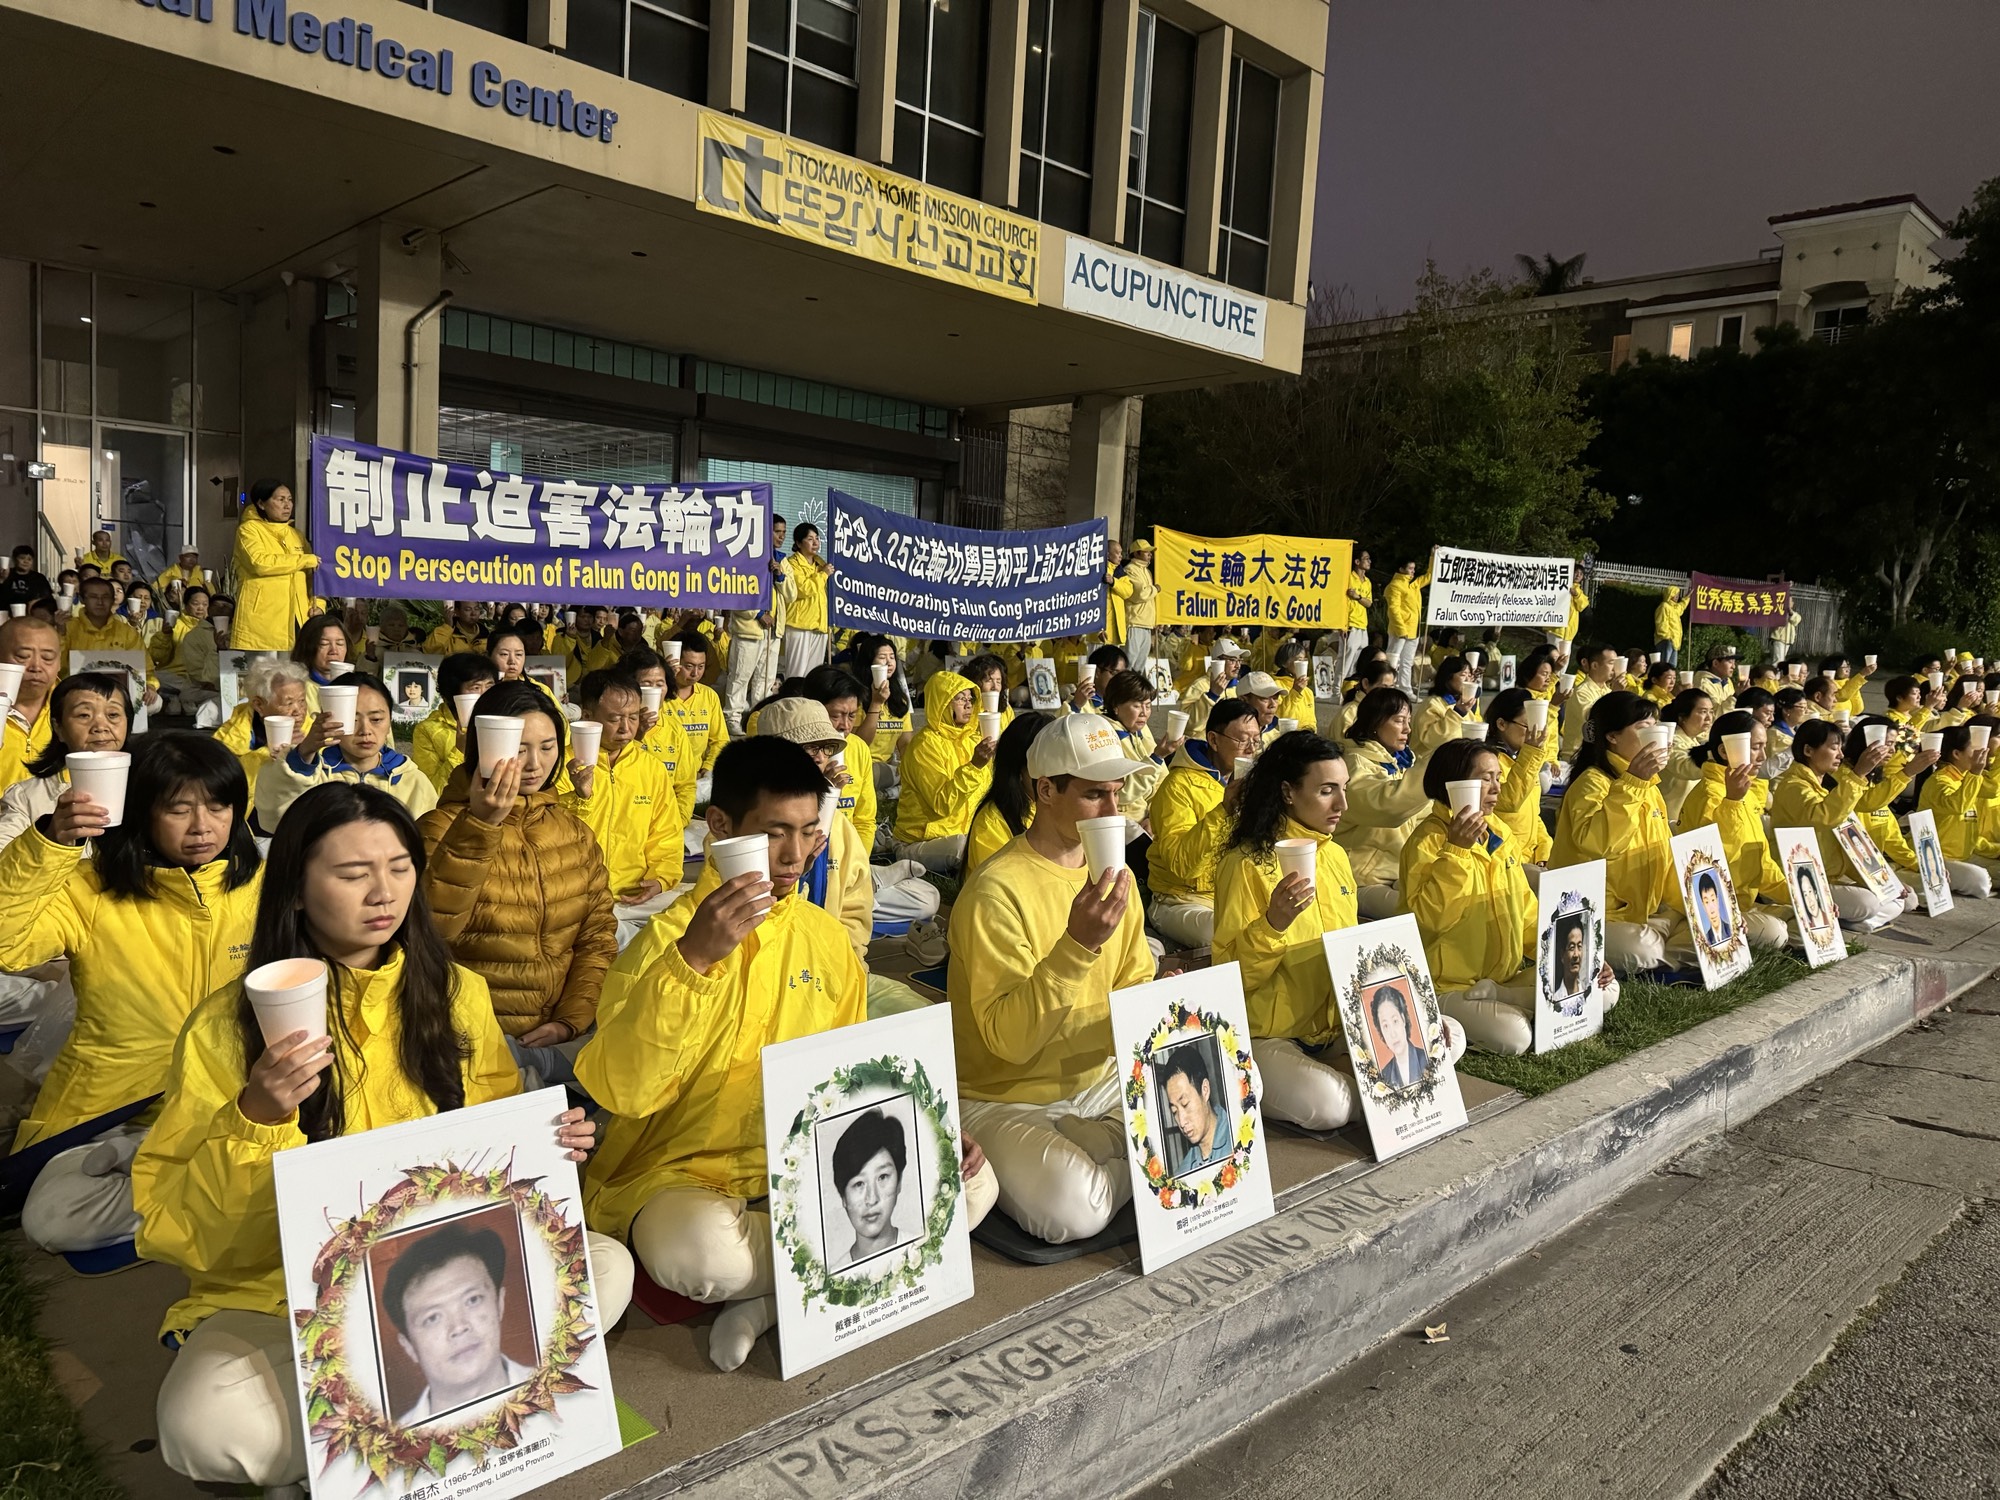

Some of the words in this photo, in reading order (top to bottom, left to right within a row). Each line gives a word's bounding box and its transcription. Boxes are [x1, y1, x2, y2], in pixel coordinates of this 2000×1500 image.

[236, 0, 453, 95] Medical
[472, 61, 618, 143] Center
[785, 149, 874, 195] TTOKAMSA
[877, 180, 921, 214] HOME
[924, 194, 981, 234] MISSION
[984, 216, 1037, 252] CHURCH
[783, 178, 1036, 298] 또감사선교교회
[1071, 253, 1258, 337] ACUPUNCTURE
[325, 448, 765, 559] 制止迫害法輪功
[335, 545, 391, 587] Stop
[400, 549, 536, 586] Persecution
[542, 557, 563, 587] of
[569, 558, 625, 590] Falun
[630, 561, 680, 598] Gong
[686, 564, 702, 593] in
[707, 565, 760, 595] China
[1185, 548, 1331, 589] 法輪大法好
[834, 570, 950, 617] Commemorating
[952, 598, 987, 617] Falun
[989, 600, 1022, 620] Gong
[835, 597, 891, 625] Peaceful
[892, 612, 936, 634] Appeal
[939, 620, 950, 636] in
[953, 622, 995, 641] Beijing
[999, 626, 1013, 639] on
[1015, 618, 1043, 639] April
[1045, 613, 1071, 633] 25th
[1075, 607, 1101, 627] 1999
[1176, 589, 1218, 618] Falun
[1226, 592, 1260, 618] Dafa
[1265, 595, 1280, 620] Is
[1286, 595, 1322, 622] Good
[1435, 608, 1458, 621] Falun
[1459, 609, 1485, 624] Gong
[1486, 610, 1536, 623] Practitioners
[1536, 612, 1543, 622] in
[1543, 610, 1564, 623] China
[1450, 590, 1501, 608] Immediately
[1501, 593, 1533, 606] Release
[1535, 594, 1557, 607] Jailed
[764, 1316, 1113, 1499] PASSENGER
[1123, 1226, 1312, 1317] LOADING
[1296, 1181, 1404, 1234] ONLY
[834, 1328, 857, 1342] Chunhua
[909, 1295, 930, 1308] Province
[456, 1477, 495, 1498] Shenyang,
[495, 1464, 525, 1481] Liaoning
[525, 1451, 555, 1468] Province
